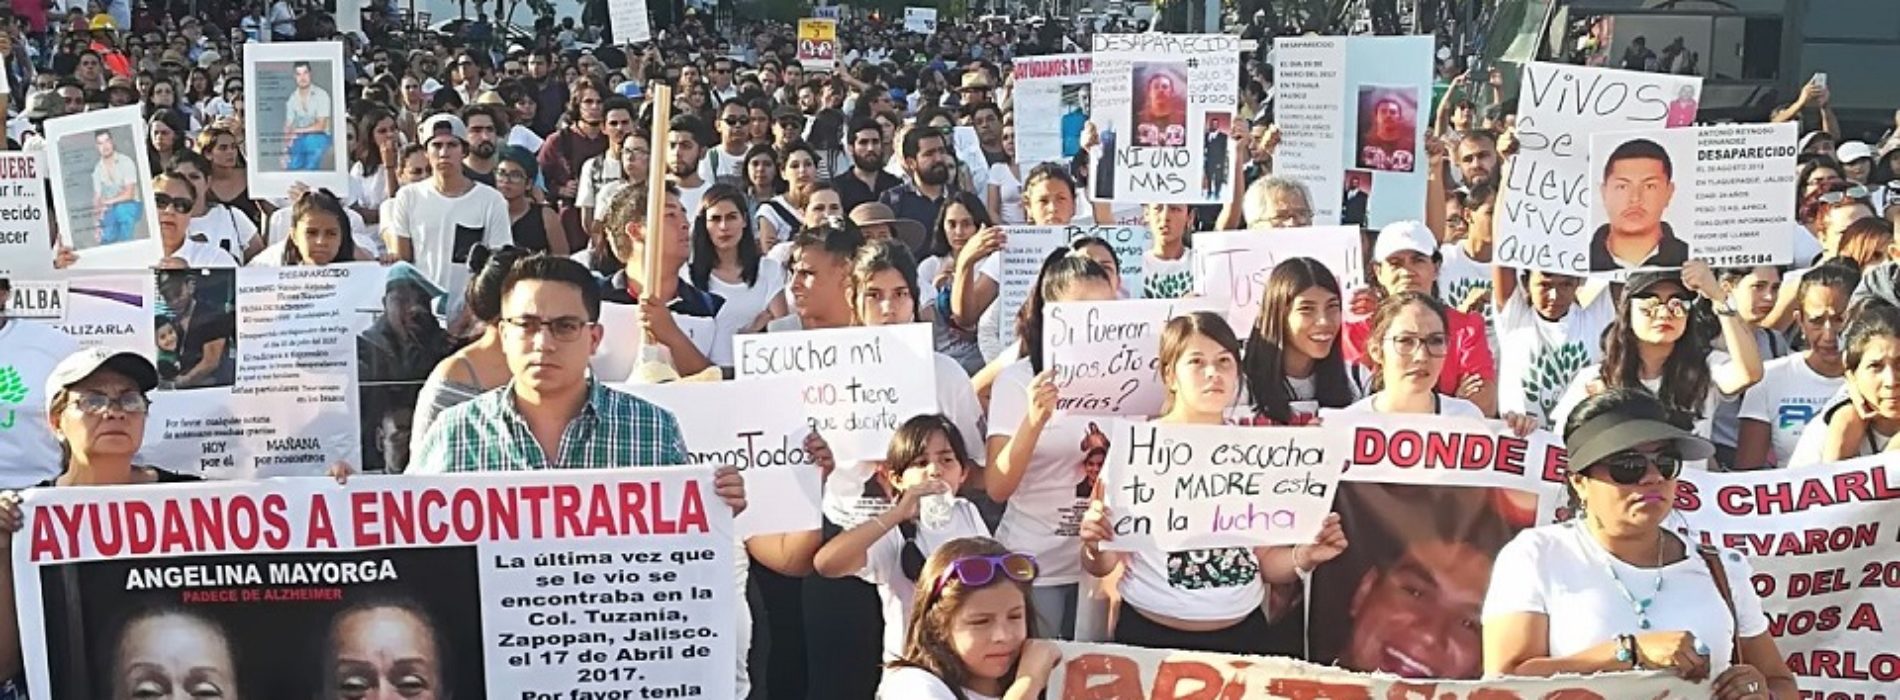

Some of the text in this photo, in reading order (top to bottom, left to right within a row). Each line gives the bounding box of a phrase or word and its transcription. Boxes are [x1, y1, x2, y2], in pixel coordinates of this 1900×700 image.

[1190, 95, 1235, 105] TODOS
[1118, 146, 1190, 168] NI UNO
[1697, 145, 1796, 161] DESAPARECIDO
[1130, 172, 1186, 194] MAS
[279, 268, 350, 280] DESAPARECIDO
[13, 288, 61, 309] ALBA
[53, 323, 135, 335] ALIZARLA
[1051, 306, 1073, 348] Si
[1087, 306, 1150, 344] fueran
[742, 339, 838, 375] Escucha
[846, 376, 899, 405] tiene
[202, 437, 320, 453] HOY MAÑANA
[1128, 425, 1325, 475] Hijo escucha
[201, 457, 220, 471] por
[254, 456, 271, 468] por
[1122, 472, 1328, 505] tu MADRE esta
[31, 480, 710, 562] AYUDANOS A ENCONTRARLA
[1114, 514, 1150, 536] en
[1167, 507, 1188, 532] la
[1212, 503, 1296, 532] lucha
[495, 549, 715, 568] La última vez que
[126, 559, 398, 590] ANGELINA MAYORGA
[536, 569, 677, 587] se le vio se
[1787, 568, 1851, 599] DEL
[183, 587, 343, 602] PADECE DE ALZHEIMER
[501, 586, 713, 608] encontraba en la
[528, 608, 688, 626] Col. Tuzanía,
[1847, 603, 1883, 632] A
[498, 626, 718, 649] Zapopan, Jalisco.
[508, 645, 711, 666] el 17 de Abril de
[578, 667, 645, 683] 2017.
[641, 684, 702, 699] tenla
